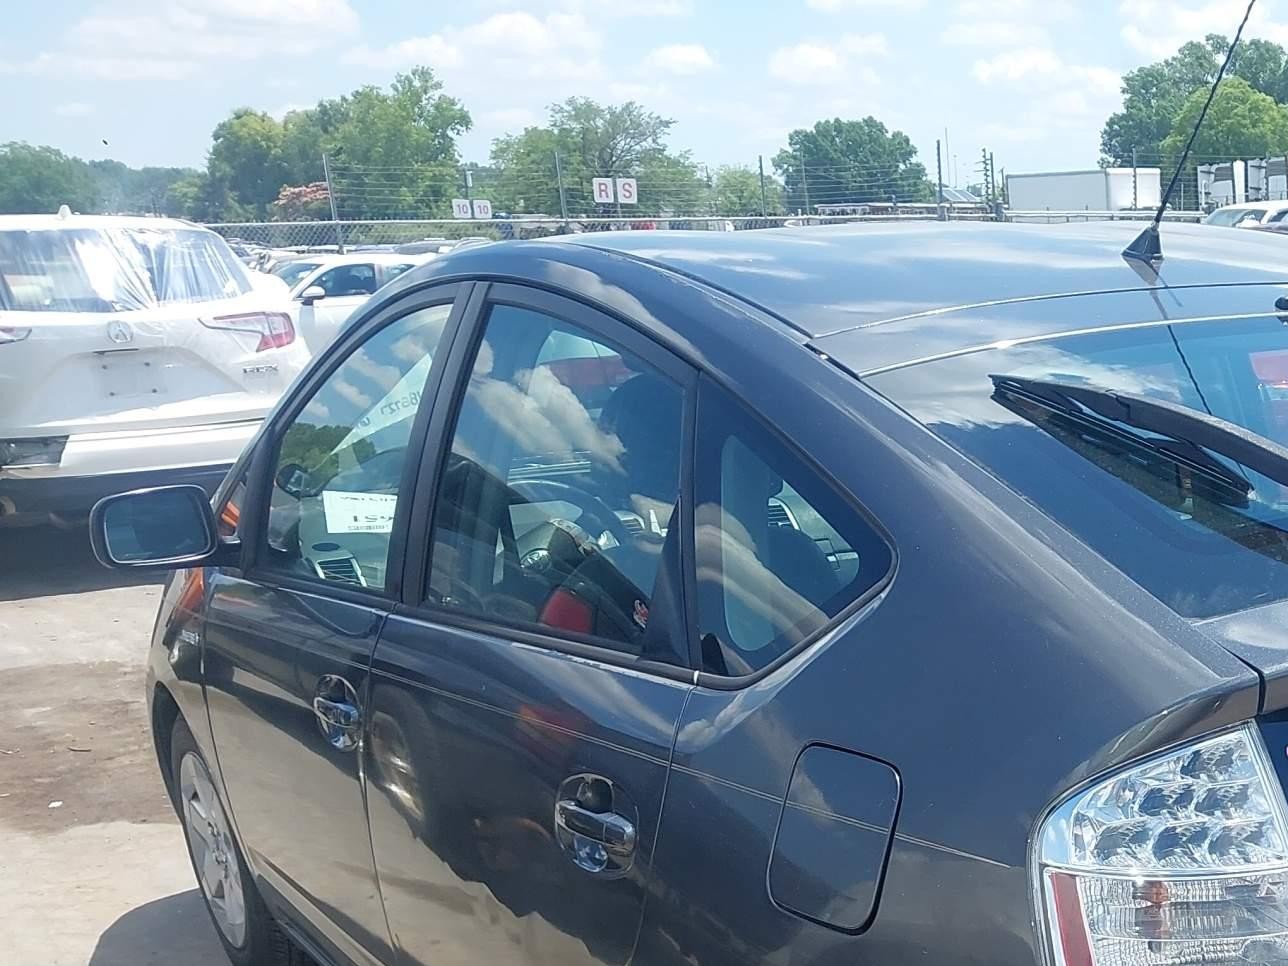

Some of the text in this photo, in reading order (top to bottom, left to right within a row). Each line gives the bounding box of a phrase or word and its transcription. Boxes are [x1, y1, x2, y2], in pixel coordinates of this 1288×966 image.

[599, 182, 633, 199] R S
[456, 204, 489, 215] 10 10
